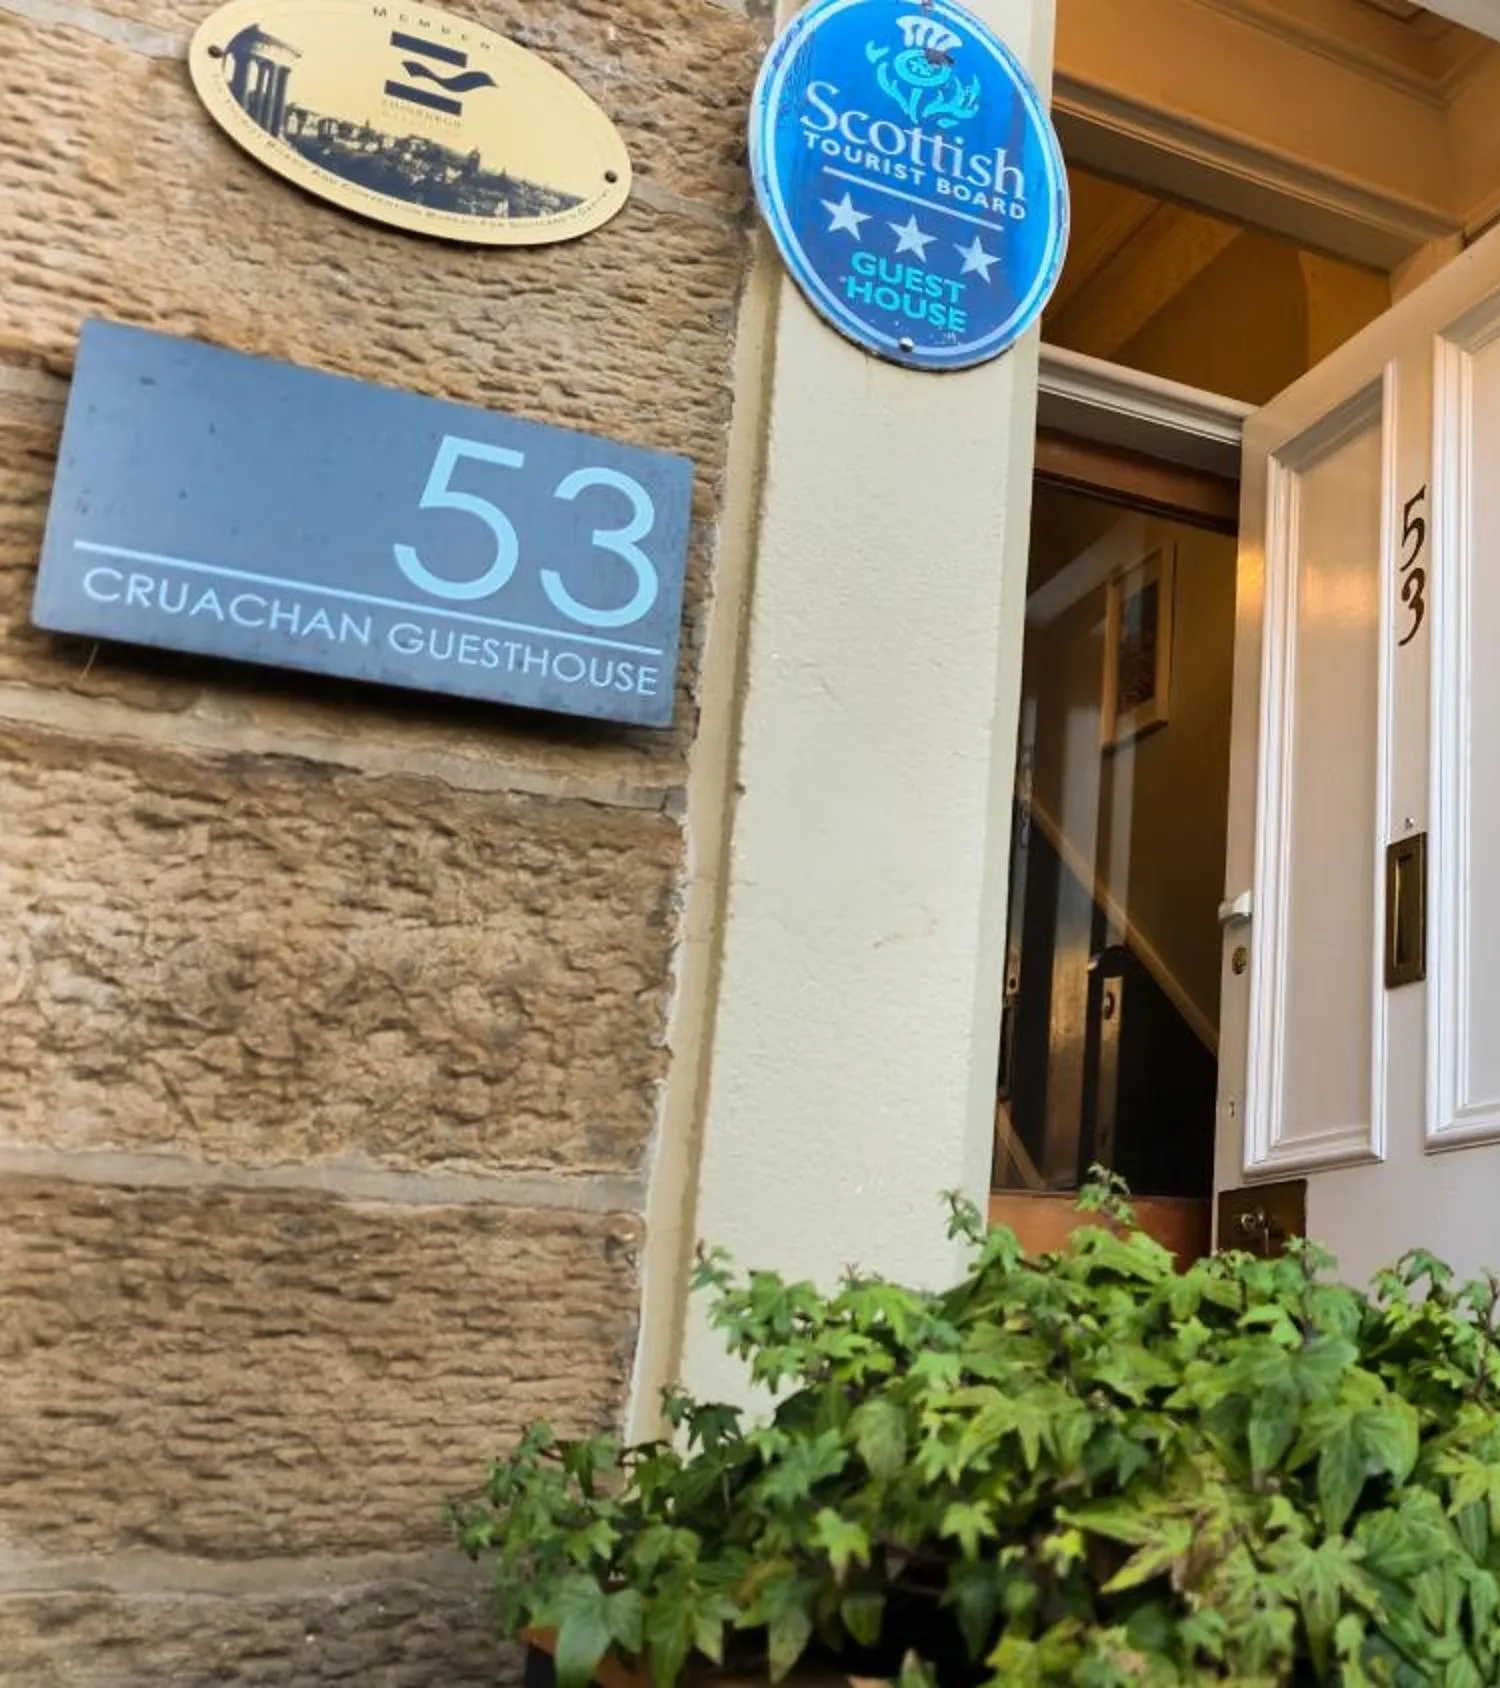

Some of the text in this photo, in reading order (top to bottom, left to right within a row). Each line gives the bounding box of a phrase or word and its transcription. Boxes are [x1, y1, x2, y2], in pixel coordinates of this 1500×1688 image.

[800, 80, 1028, 201] Scottish
[802, 130, 1027, 220] TOURIST BOARD
[843, 275, 969, 333] HOUSE
[851, 251, 967, 304] GUEST
[392, 435, 660, 628] 53
[1397, 483, 1427, 647] 53
[82, 566, 660, 697] CRUACHAN GUESTHOUSE
